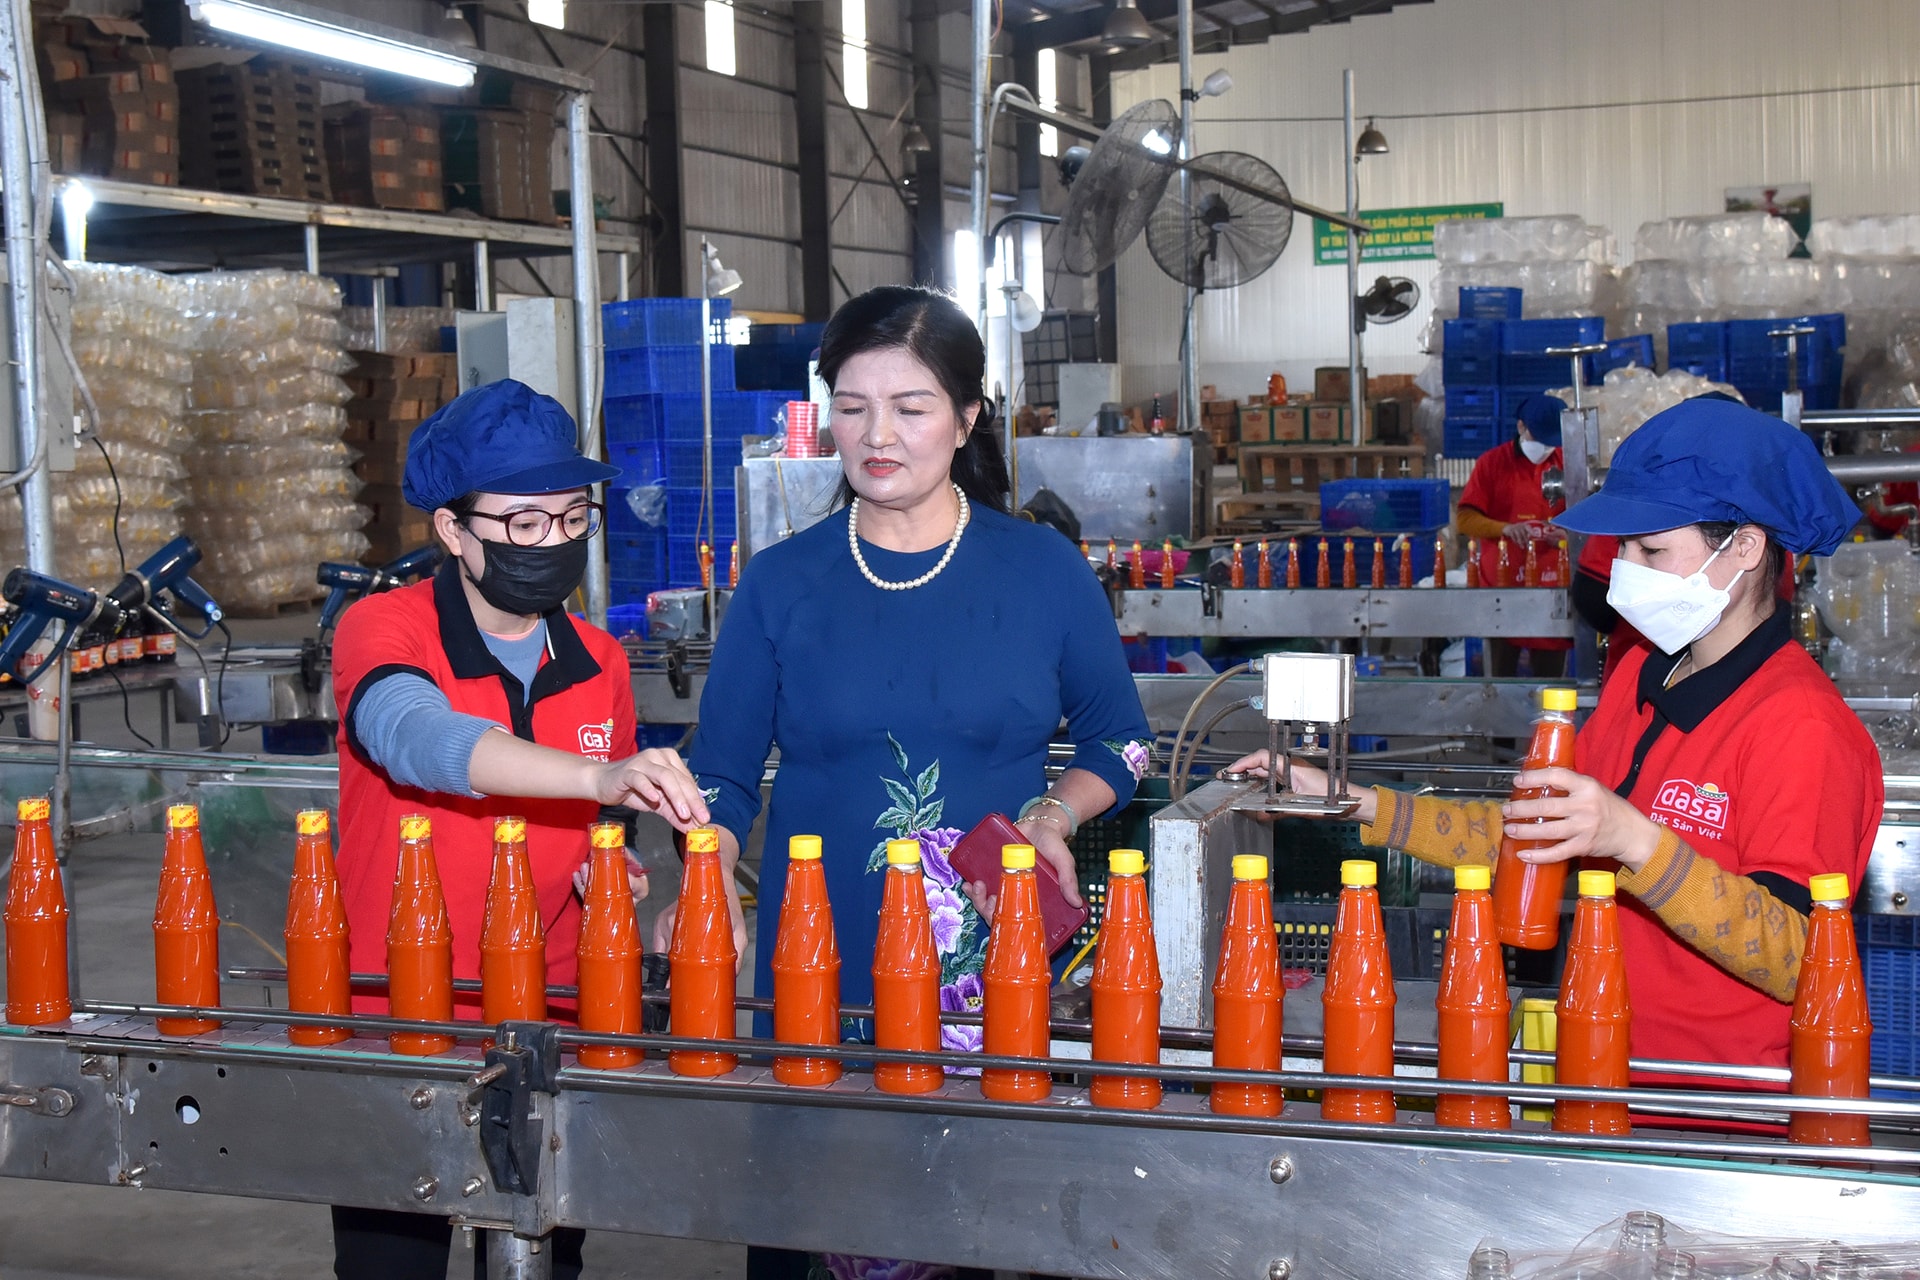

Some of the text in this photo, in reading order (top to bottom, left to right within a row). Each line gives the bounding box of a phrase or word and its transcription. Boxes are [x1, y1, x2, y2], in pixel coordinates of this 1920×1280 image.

[583, 730, 611, 749] das
[1661, 785, 1722, 822] dasa
[179, 811, 193, 824] dasa
[1672, 818, 1693, 832] Sản
[1698, 826, 1722, 840] Việt
[611, 831, 624, 846] dasa
[699, 836, 713, 850] dasa
